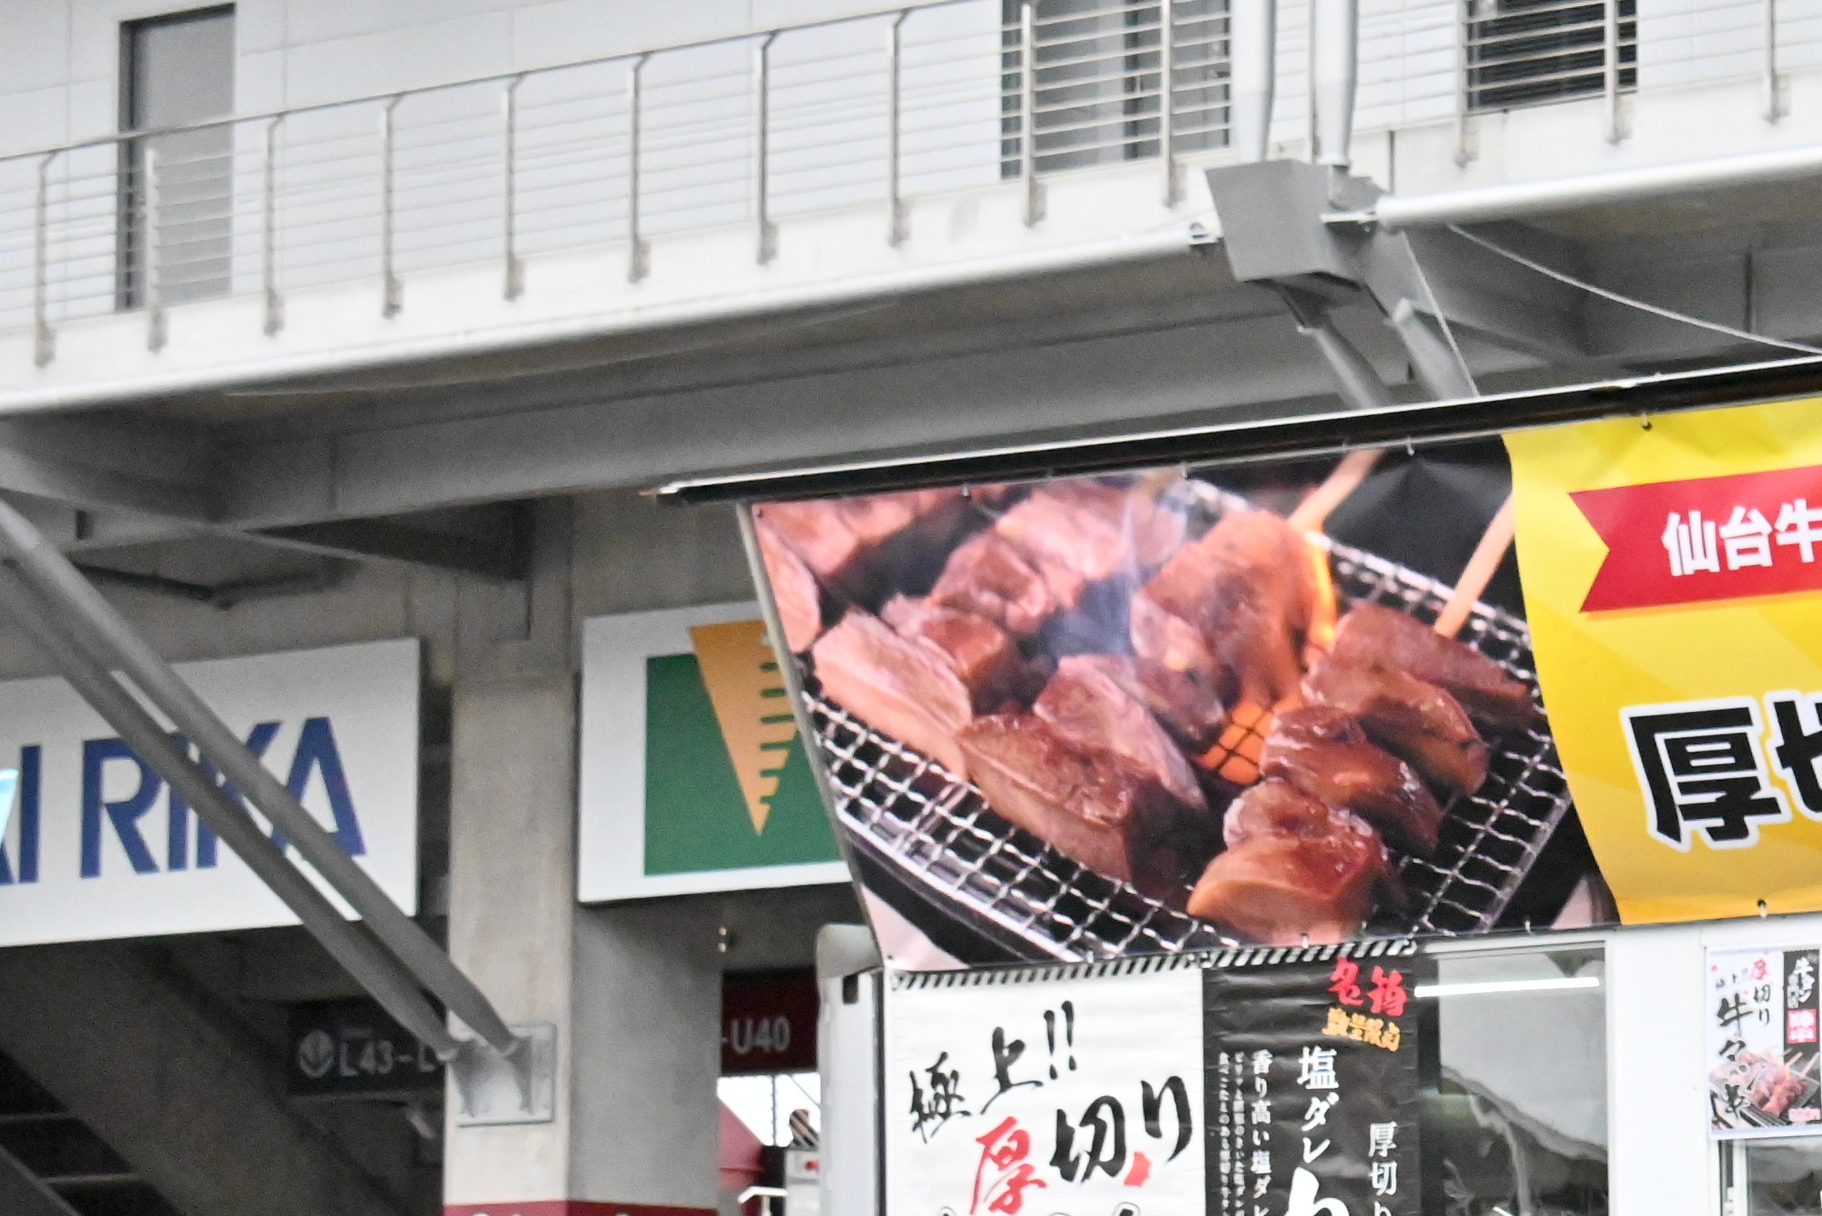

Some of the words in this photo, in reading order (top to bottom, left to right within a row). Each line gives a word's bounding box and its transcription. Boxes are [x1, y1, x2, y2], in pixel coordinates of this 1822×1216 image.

[970, 1074, 1193, 1216] 厚切り
[1297, 1046, 1340, 1164] 塩ダレ
